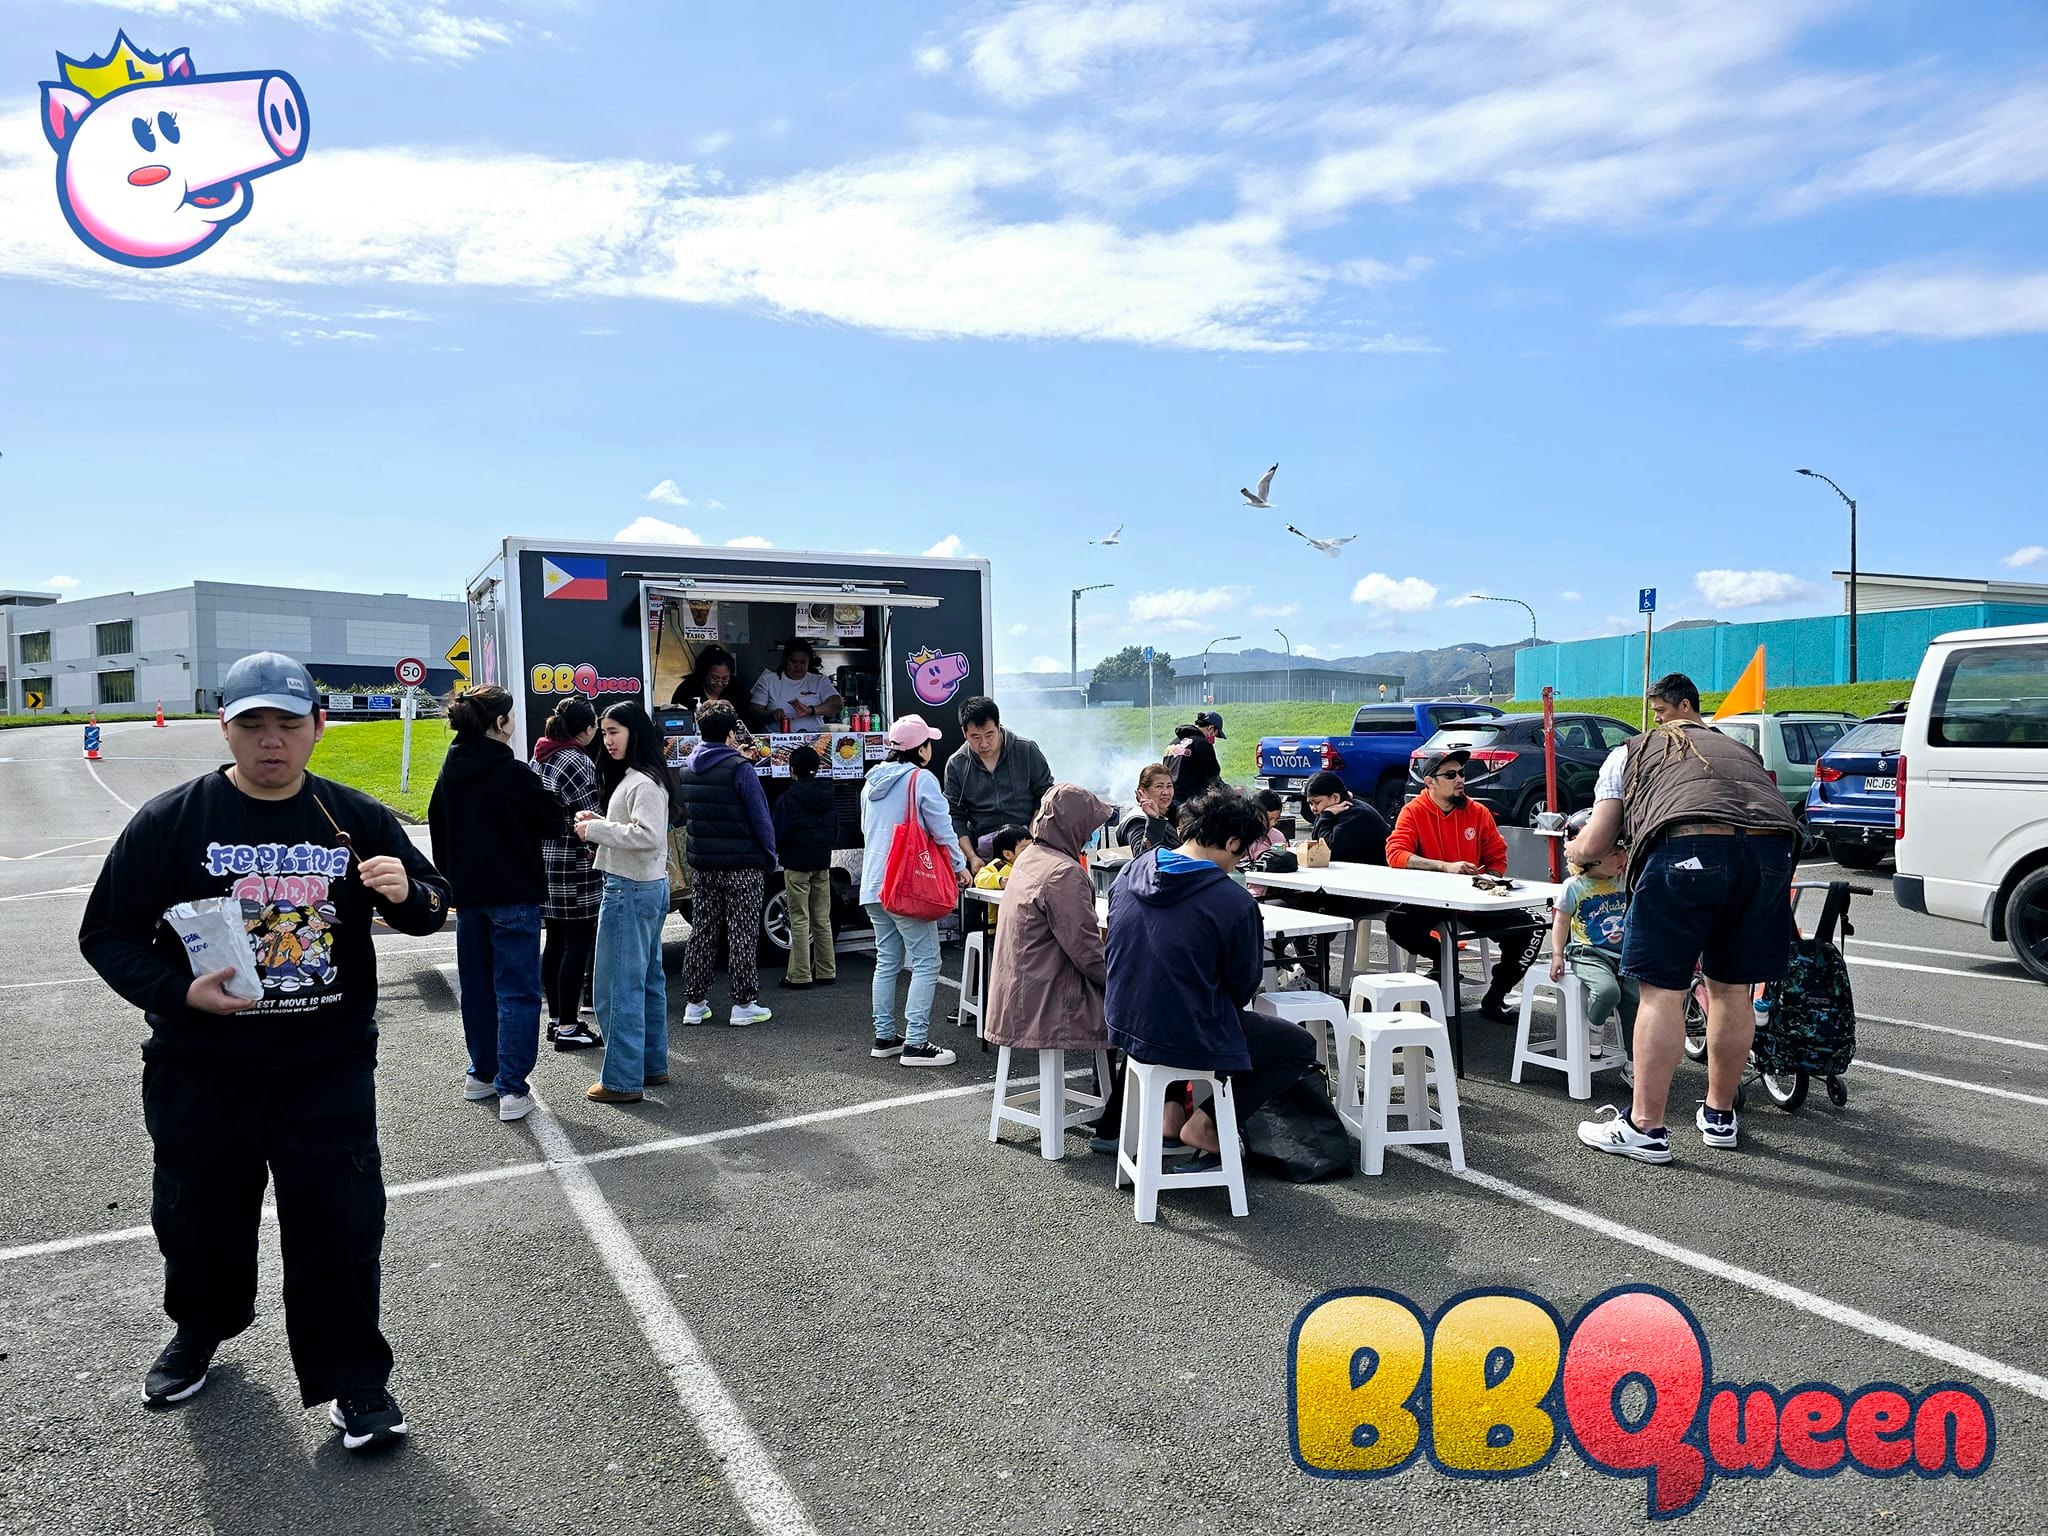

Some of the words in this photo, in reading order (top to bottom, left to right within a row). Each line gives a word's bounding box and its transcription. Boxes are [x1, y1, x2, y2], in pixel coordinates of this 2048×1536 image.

[403, 666, 420, 677] 50
[532, 664, 640, 698] BBQueen
[1270, 756, 1311, 768] TOYOTA
[1866, 779, 1897, 788] NCJ69
[257, 1000, 276, 1008] EST
[279, 998, 307, 1008] MOVE
[310, 997, 319, 1005] IS
[320, 993, 343, 1004] RIGHT
